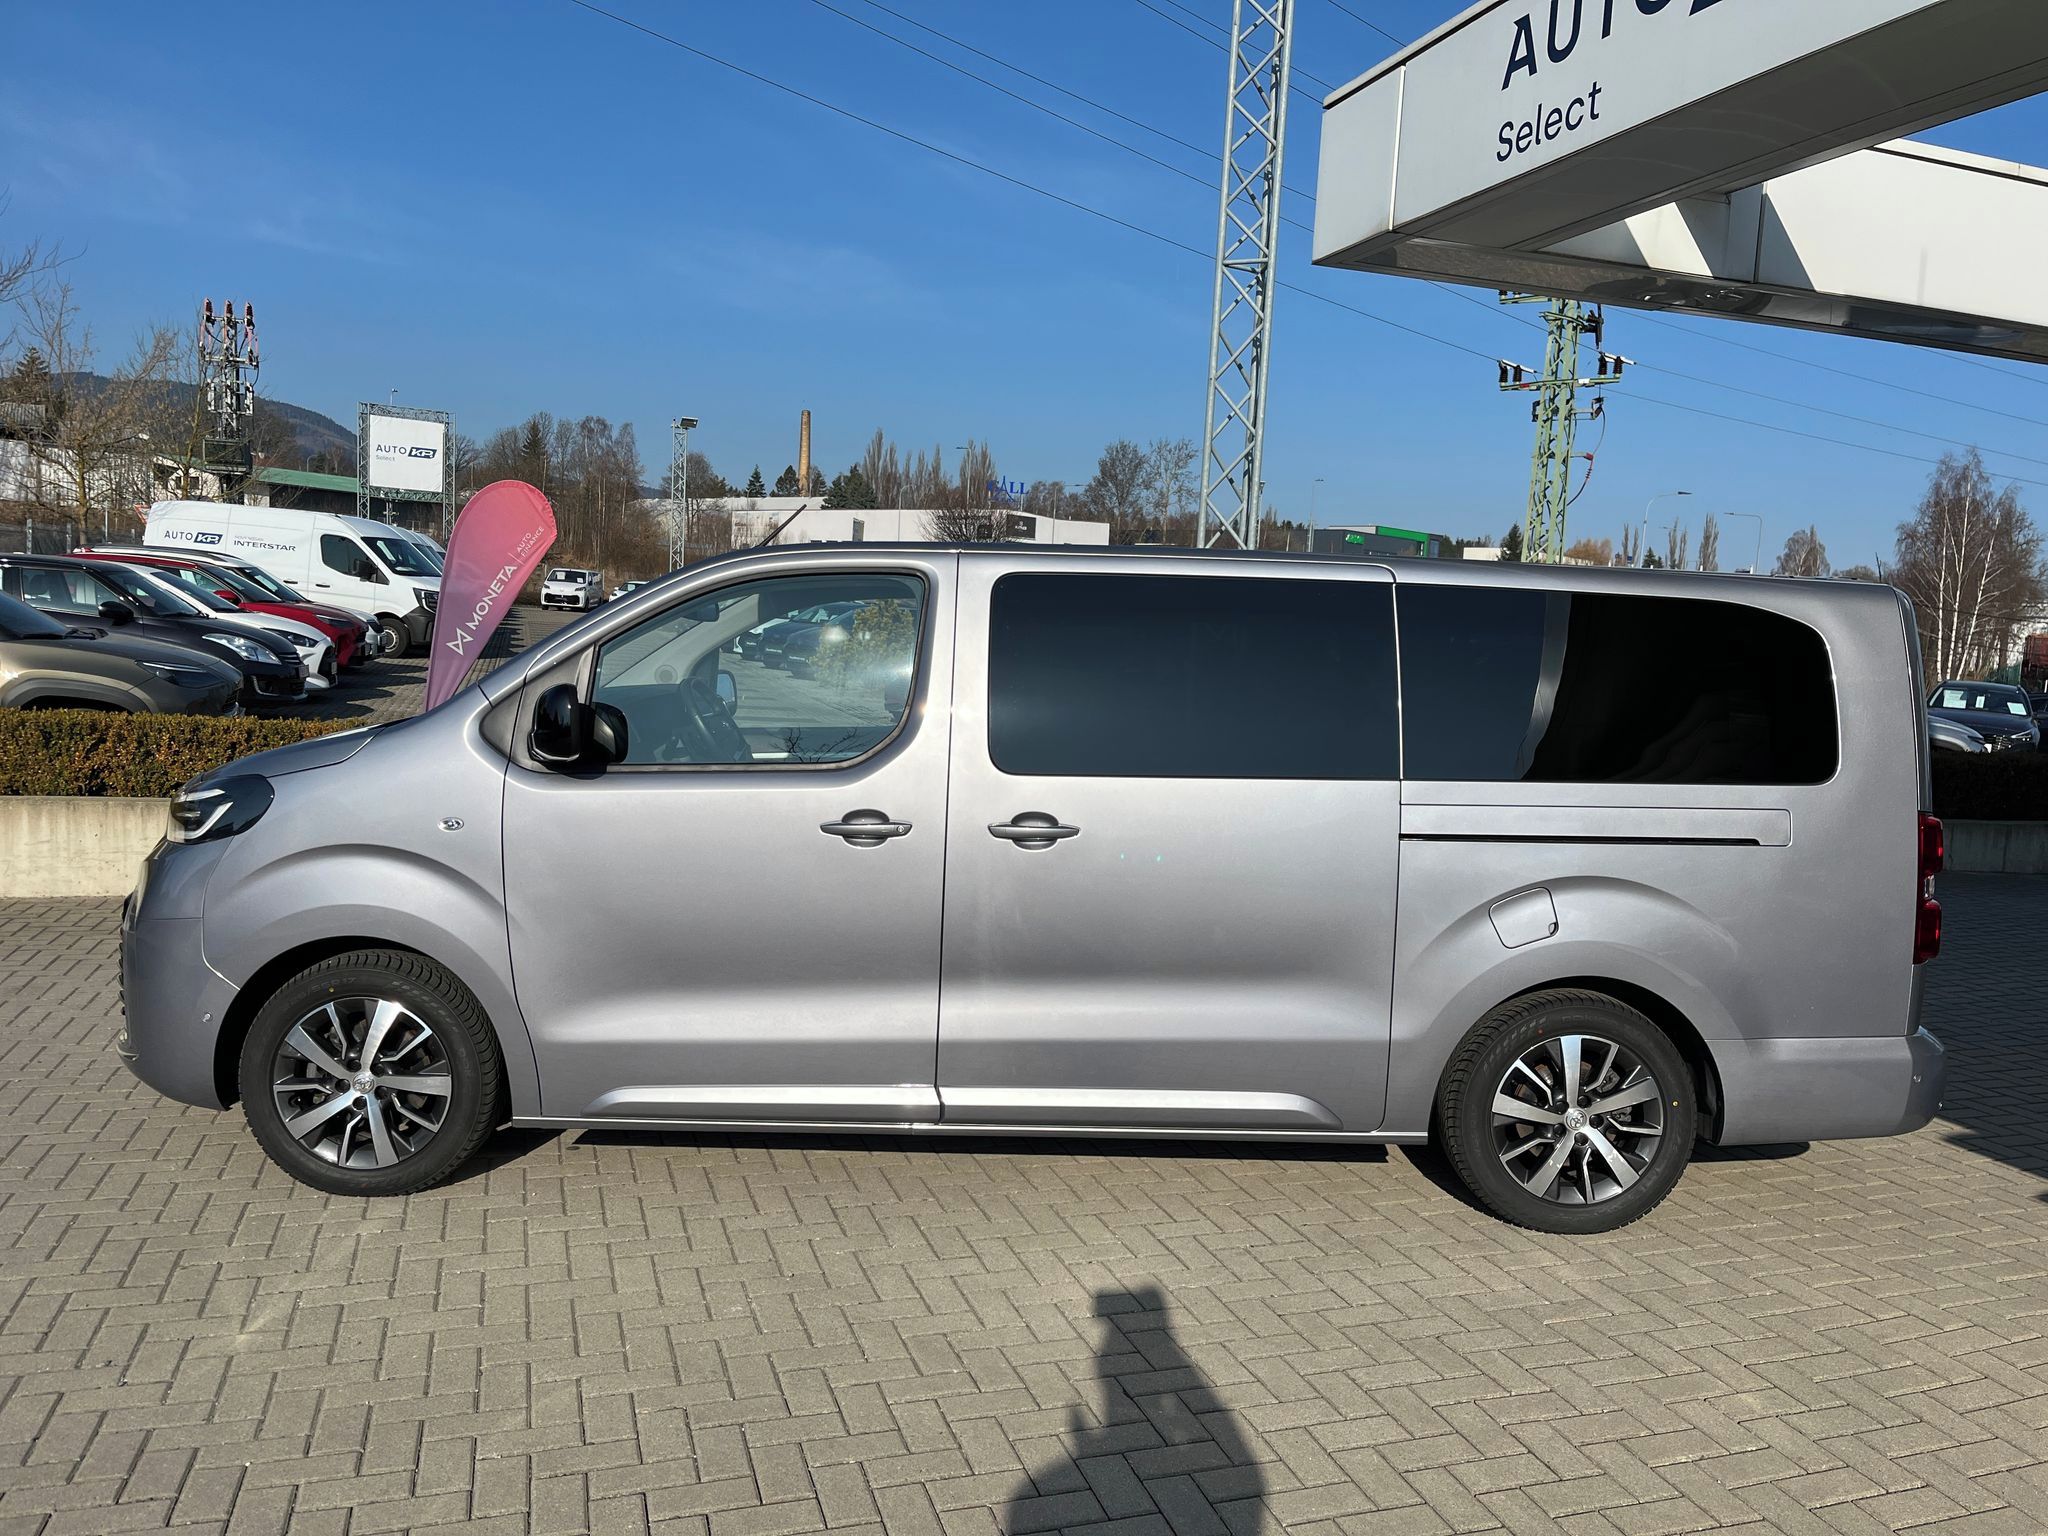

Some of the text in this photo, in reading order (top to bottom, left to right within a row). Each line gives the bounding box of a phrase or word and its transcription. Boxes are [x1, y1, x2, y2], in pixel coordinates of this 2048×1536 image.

[1501, 0, 1671, 90] AU
[1497, 81, 1602, 162] Select
[376, 444, 407, 455] AUTO
[164, 530, 193, 541] AUTO
[233, 540, 296, 552] INTERSTAR
[516, 532, 532, 553] AUTO
[520, 527, 545, 558] FINANCE
[465, 565, 517, 631] MONETA
